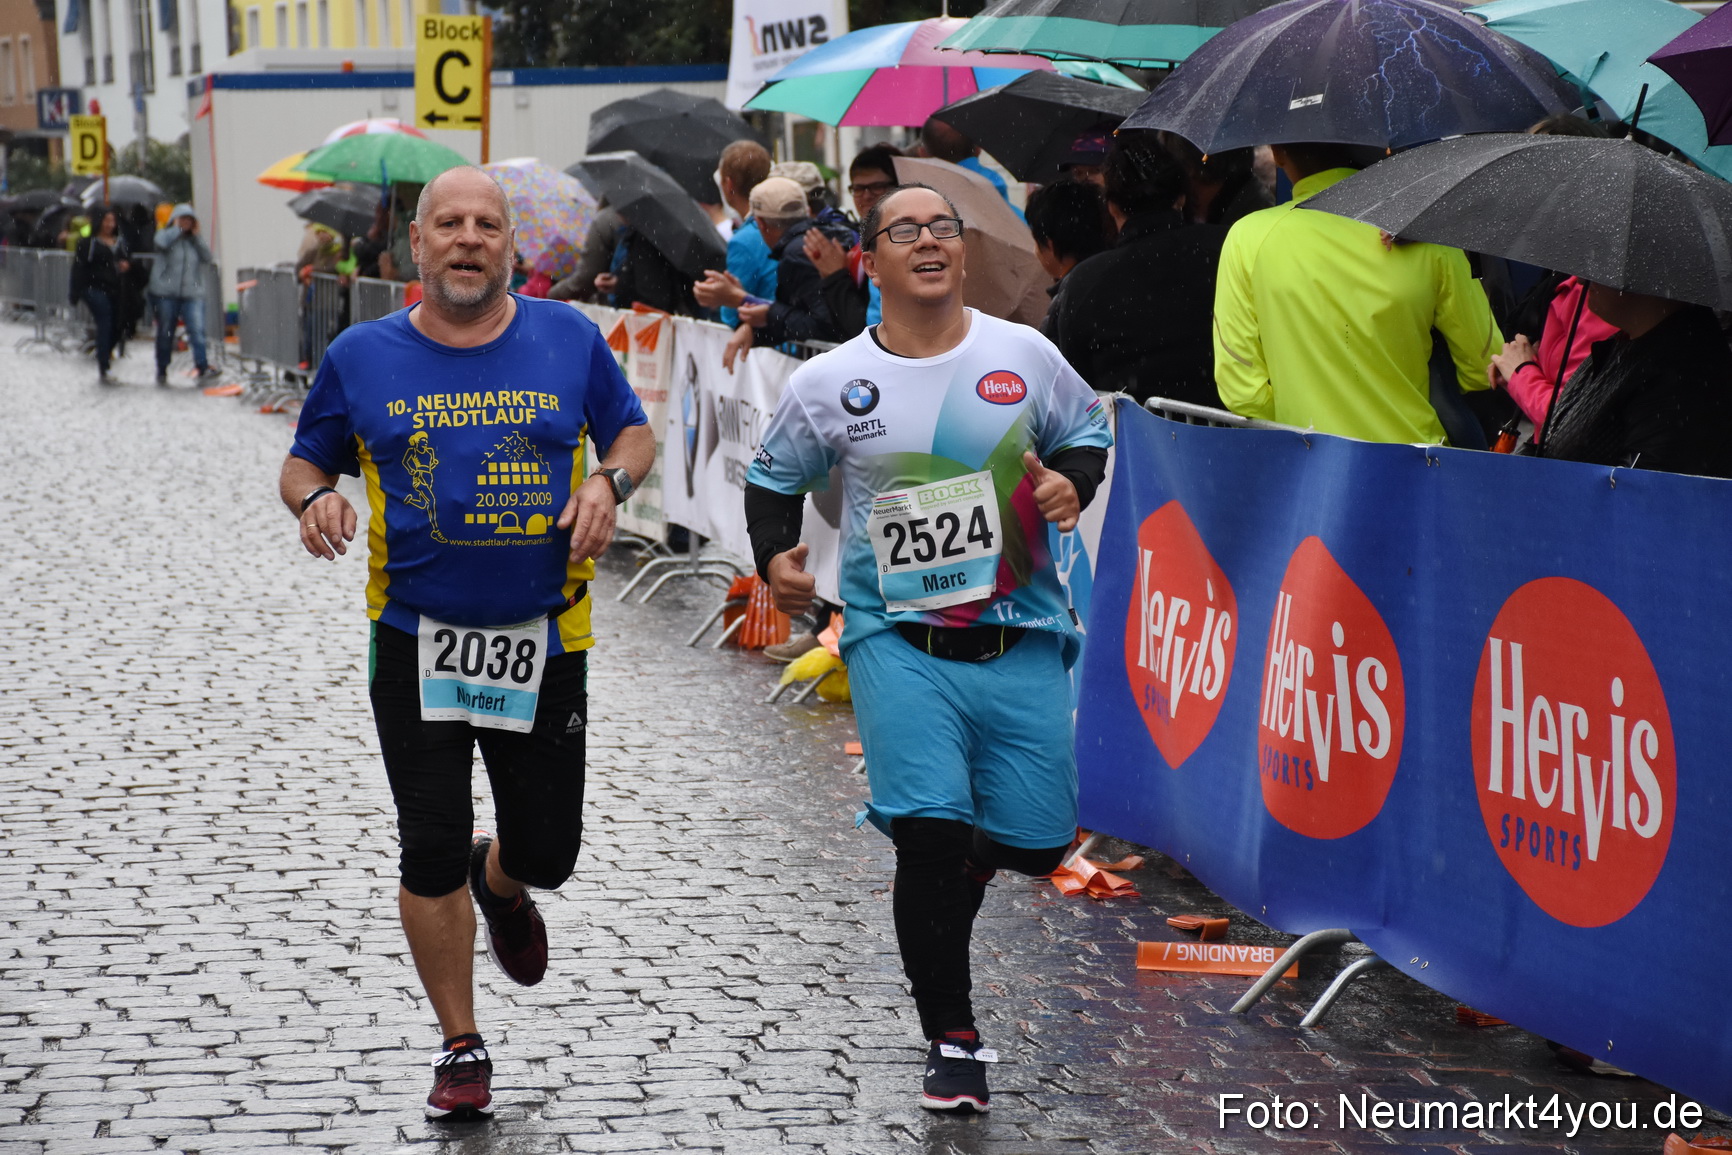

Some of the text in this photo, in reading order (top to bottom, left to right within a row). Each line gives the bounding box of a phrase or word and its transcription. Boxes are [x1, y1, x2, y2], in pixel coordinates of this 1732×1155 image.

[424, 19, 483, 41] Block
[433, 49, 471, 105] C
[80, 133, 98, 160] D
[984, 380, 1022, 395] Hervis
[386, 390, 560, 417] 10. NEUMARKTER
[412, 408, 537, 429] STADTLAUF
[847, 418, 886, 436] PARTL
[849, 429, 887, 443] Neumarkt
[475, 492, 552, 507] 20.09.2009
[917, 478, 983, 505] BOCK
[873, 503, 912, 515] NeuerMarkt
[449, 536, 553, 547] www.stadtlauf-neumarkt.de
[883, 505, 994, 566] 2524
[922, 571, 966, 592] Marc
[993, 601, 1020, 622] 17.
[434, 628, 537, 684] 2038
[1262, 590, 1391, 783] Hervis
[456, 686, 506, 711] Norbert
[1488, 637, 1663, 862] Hervis
[1261, 743, 1314, 791] SPORTS
[1501, 813, 1581, 871] SPORTS
[1177, 944, 1275, 963] BRANDING
